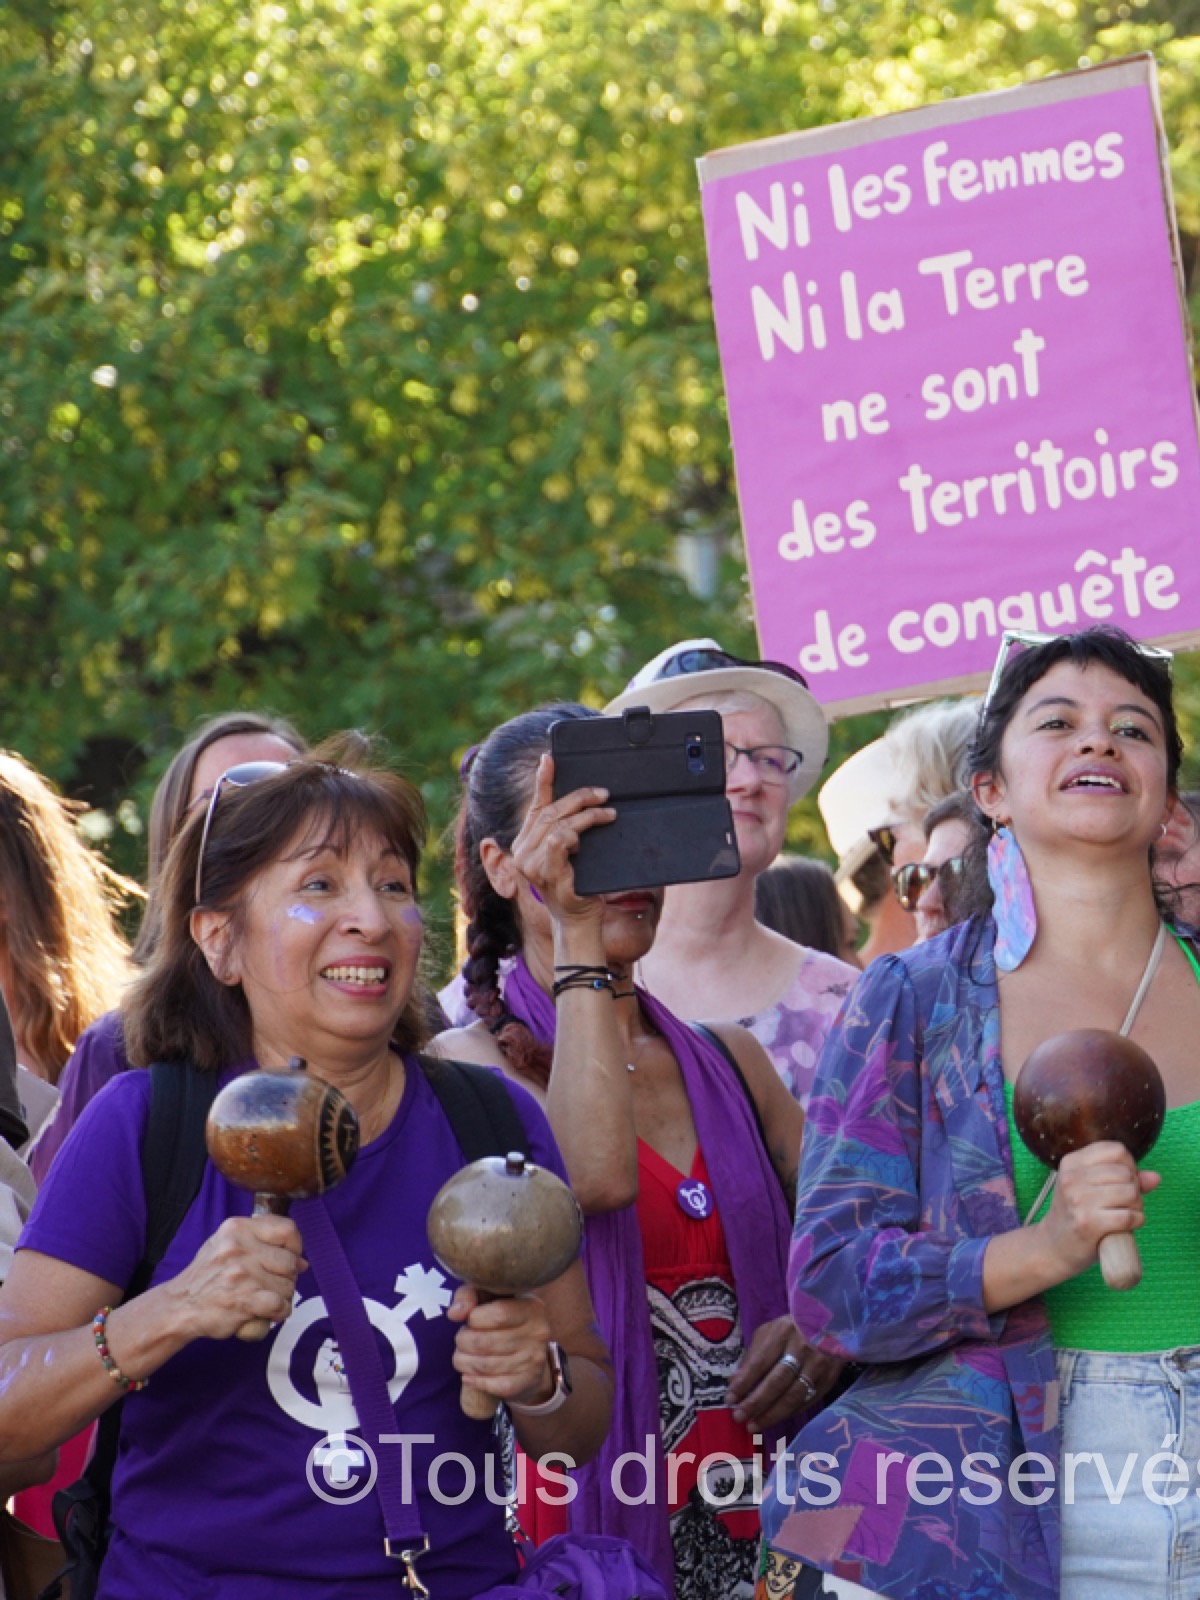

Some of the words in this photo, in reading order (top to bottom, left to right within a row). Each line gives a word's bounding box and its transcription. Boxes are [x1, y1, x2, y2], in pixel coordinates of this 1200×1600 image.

[735, 181, 810, 261] Ni
[827, 164, 912, 233] les
[923, 131, 1125, 206] femmes
[750, 271, 827, 361] Ni
[840, 271, 905, 341] la
[918, 249, 1089, 316] Terre
[821, 392, 890, 442] ne
[921, 328, 1045, 421] sont
[777, 499, 877, 561] des
[898, 428, 1179, 534] territoirs
[797, 609, 869, 674] de
[887, 546, 1181, 654] conquête
